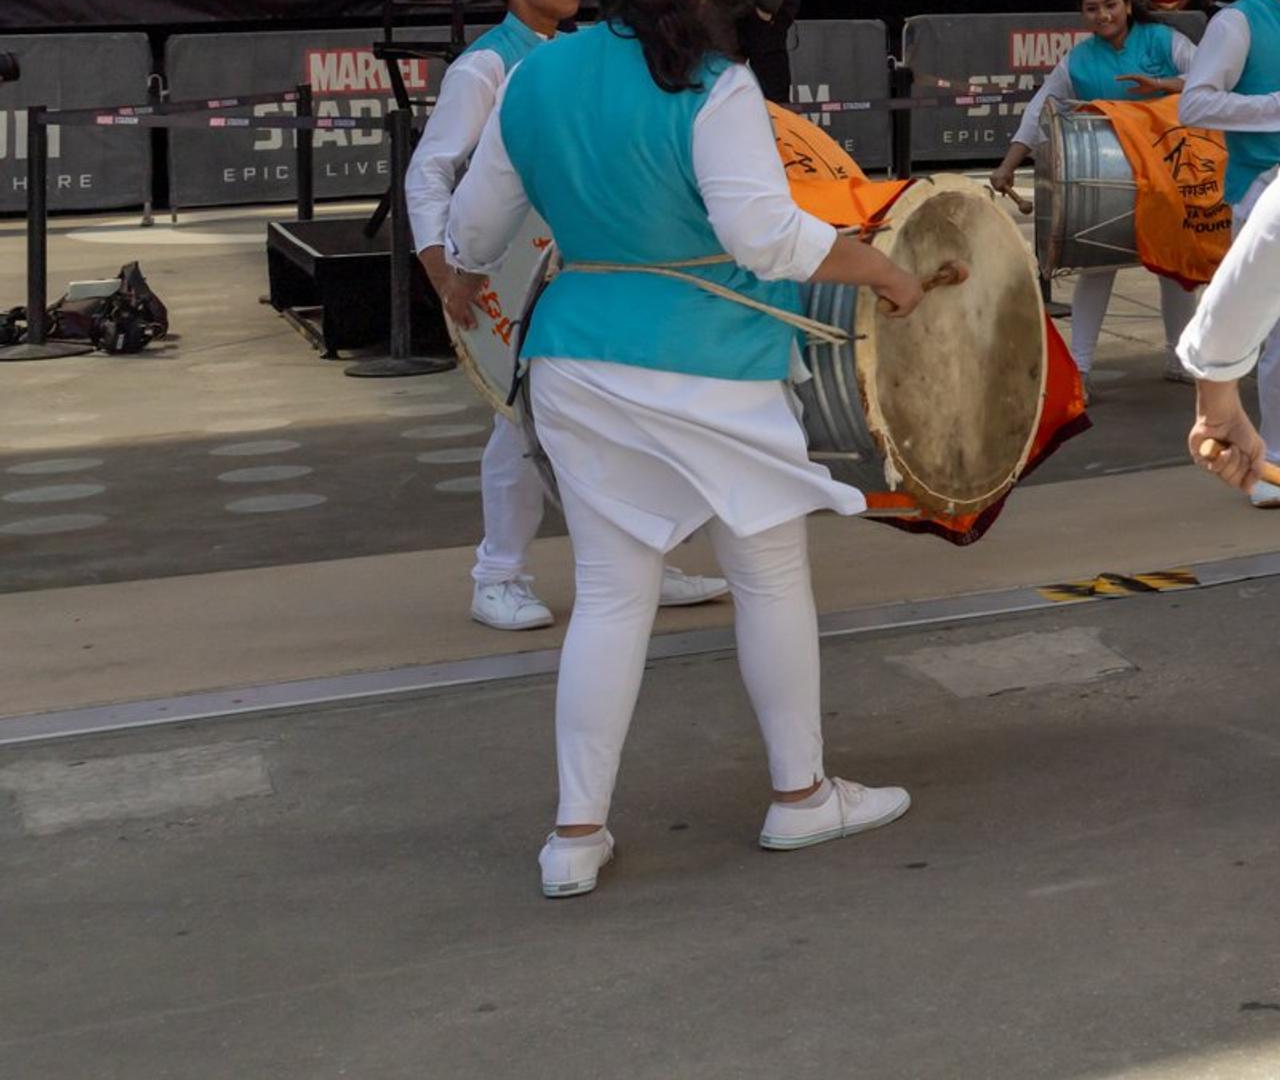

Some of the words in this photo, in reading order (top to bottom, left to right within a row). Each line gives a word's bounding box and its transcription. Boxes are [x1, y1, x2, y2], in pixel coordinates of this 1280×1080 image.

[943, 130, 995, 143] EPIC
[12, 173, 92, 190] HRE
[223, 166, 289, 182] EPIC
